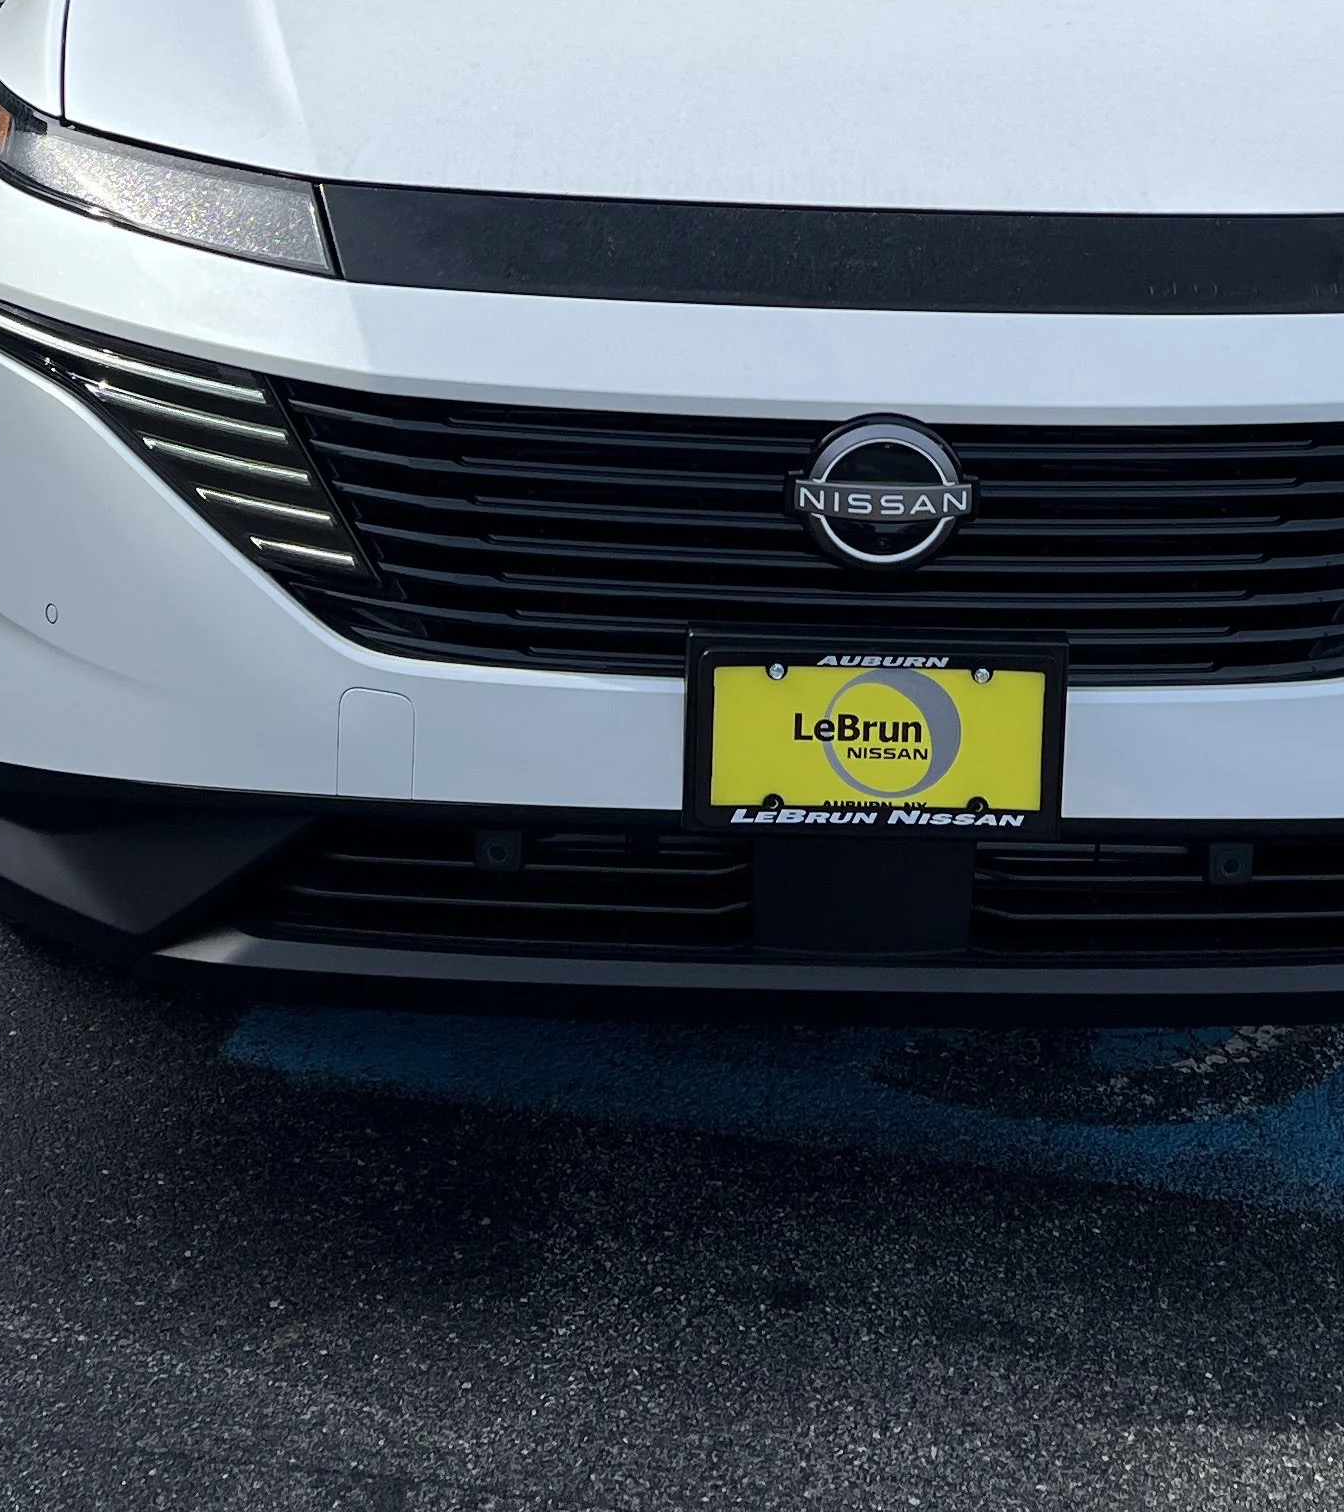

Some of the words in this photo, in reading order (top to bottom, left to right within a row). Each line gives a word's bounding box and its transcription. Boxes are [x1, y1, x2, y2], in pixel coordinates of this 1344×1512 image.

[799, 487, 968, 516] NISSAN
[817, 655, 950, 668] AUBURN
[793, 713, 922, 743] LeBrun
[847, 747, 929, 761] NISSAN
